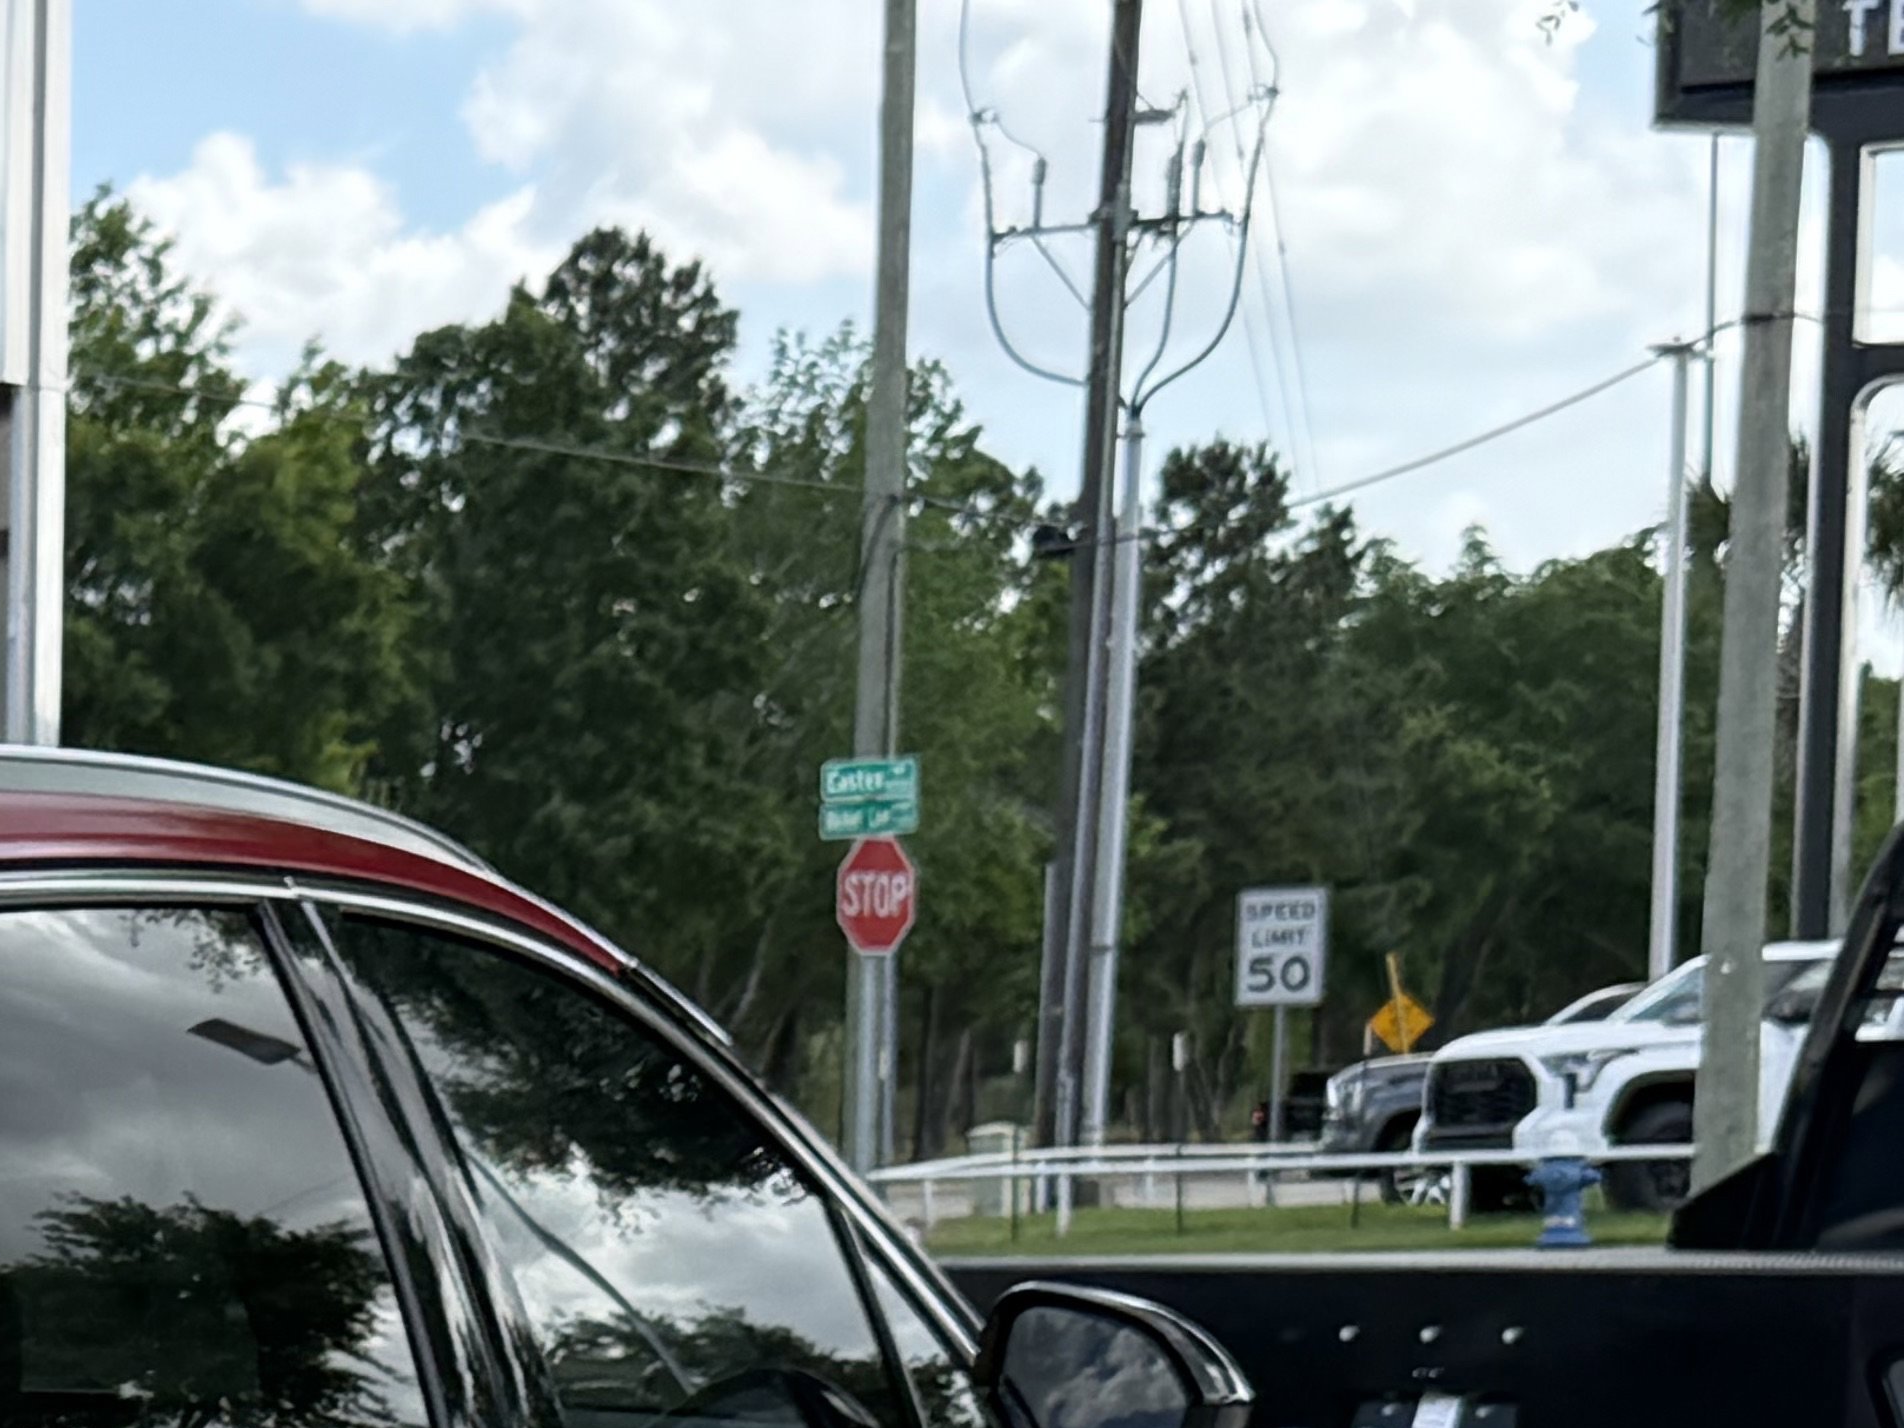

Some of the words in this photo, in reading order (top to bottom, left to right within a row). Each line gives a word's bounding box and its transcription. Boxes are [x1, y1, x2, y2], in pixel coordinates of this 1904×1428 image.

[842, 872, 908, 918] STOP
[1246, 901, 1315, 921] SPEED
[1251, 928, 1307, 948] LIMIT
[1247, 955, 1311, 993] 50
